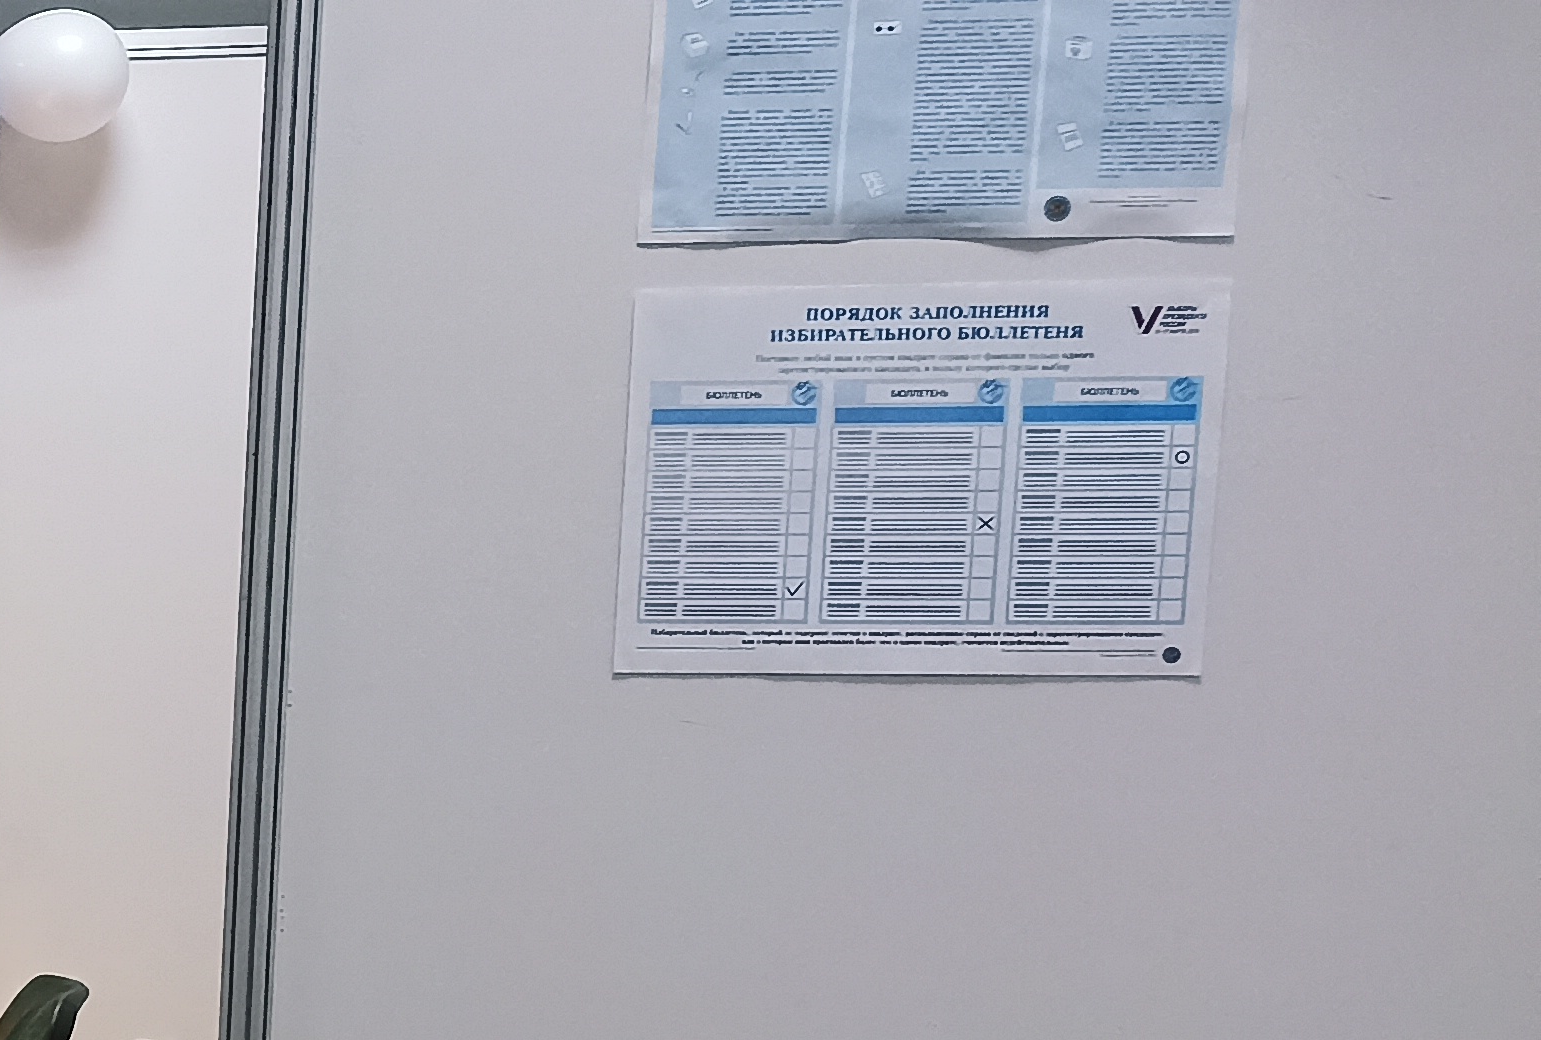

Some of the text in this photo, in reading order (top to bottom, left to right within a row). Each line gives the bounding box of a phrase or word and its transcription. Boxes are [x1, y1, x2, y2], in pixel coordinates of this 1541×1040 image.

[806, 304, 1050, 322] ПОРЯДОК ЗАПОЛНЕНИЯ
[770, 325, 1084, 343] ИЗБИРАТЕЛЬНОГО БЮЛЛЕТЕНЯ
